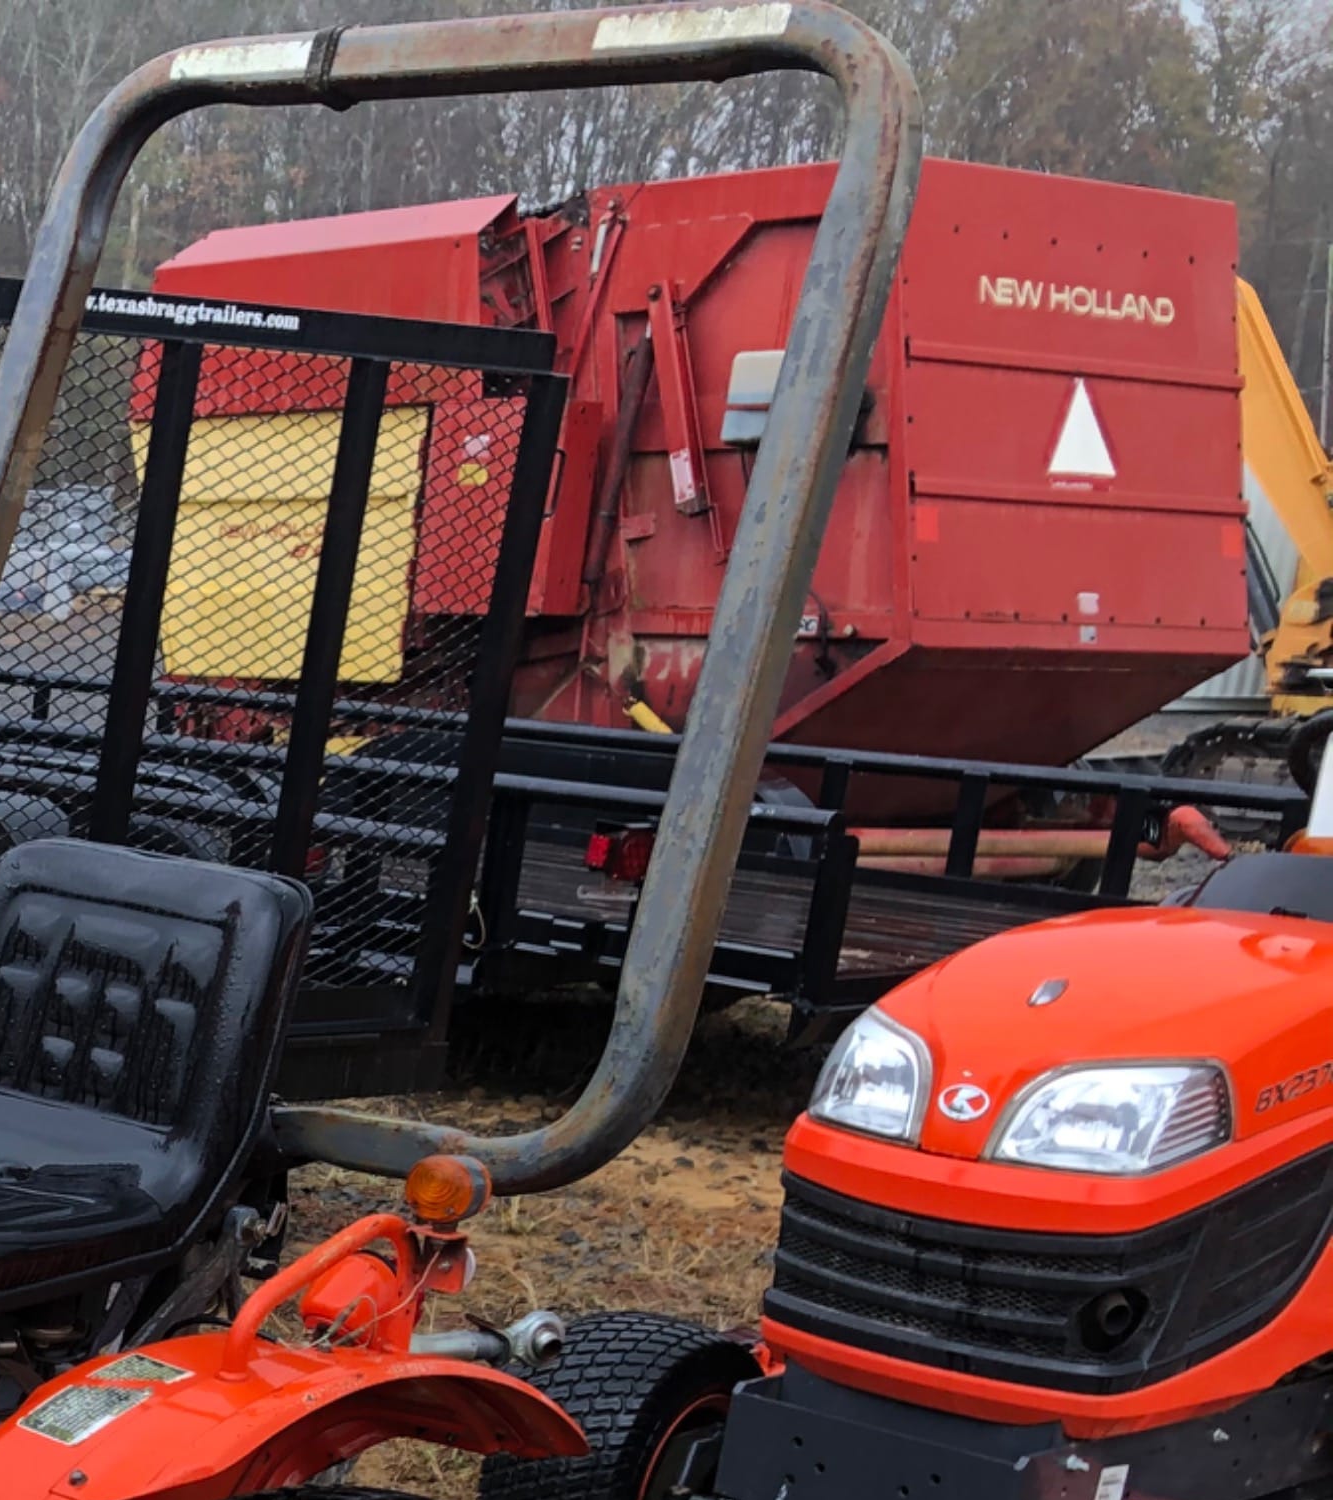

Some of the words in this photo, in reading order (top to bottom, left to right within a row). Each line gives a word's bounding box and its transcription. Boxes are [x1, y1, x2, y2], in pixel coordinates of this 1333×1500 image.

[84, 291, 301, 331] w.texasbraggtrailers.com
[979, 274, 1044, 309] NEW
[1049, 282, 1176, 326] HOLLAND
[1254, 1060, 1333, 1113] BX237
